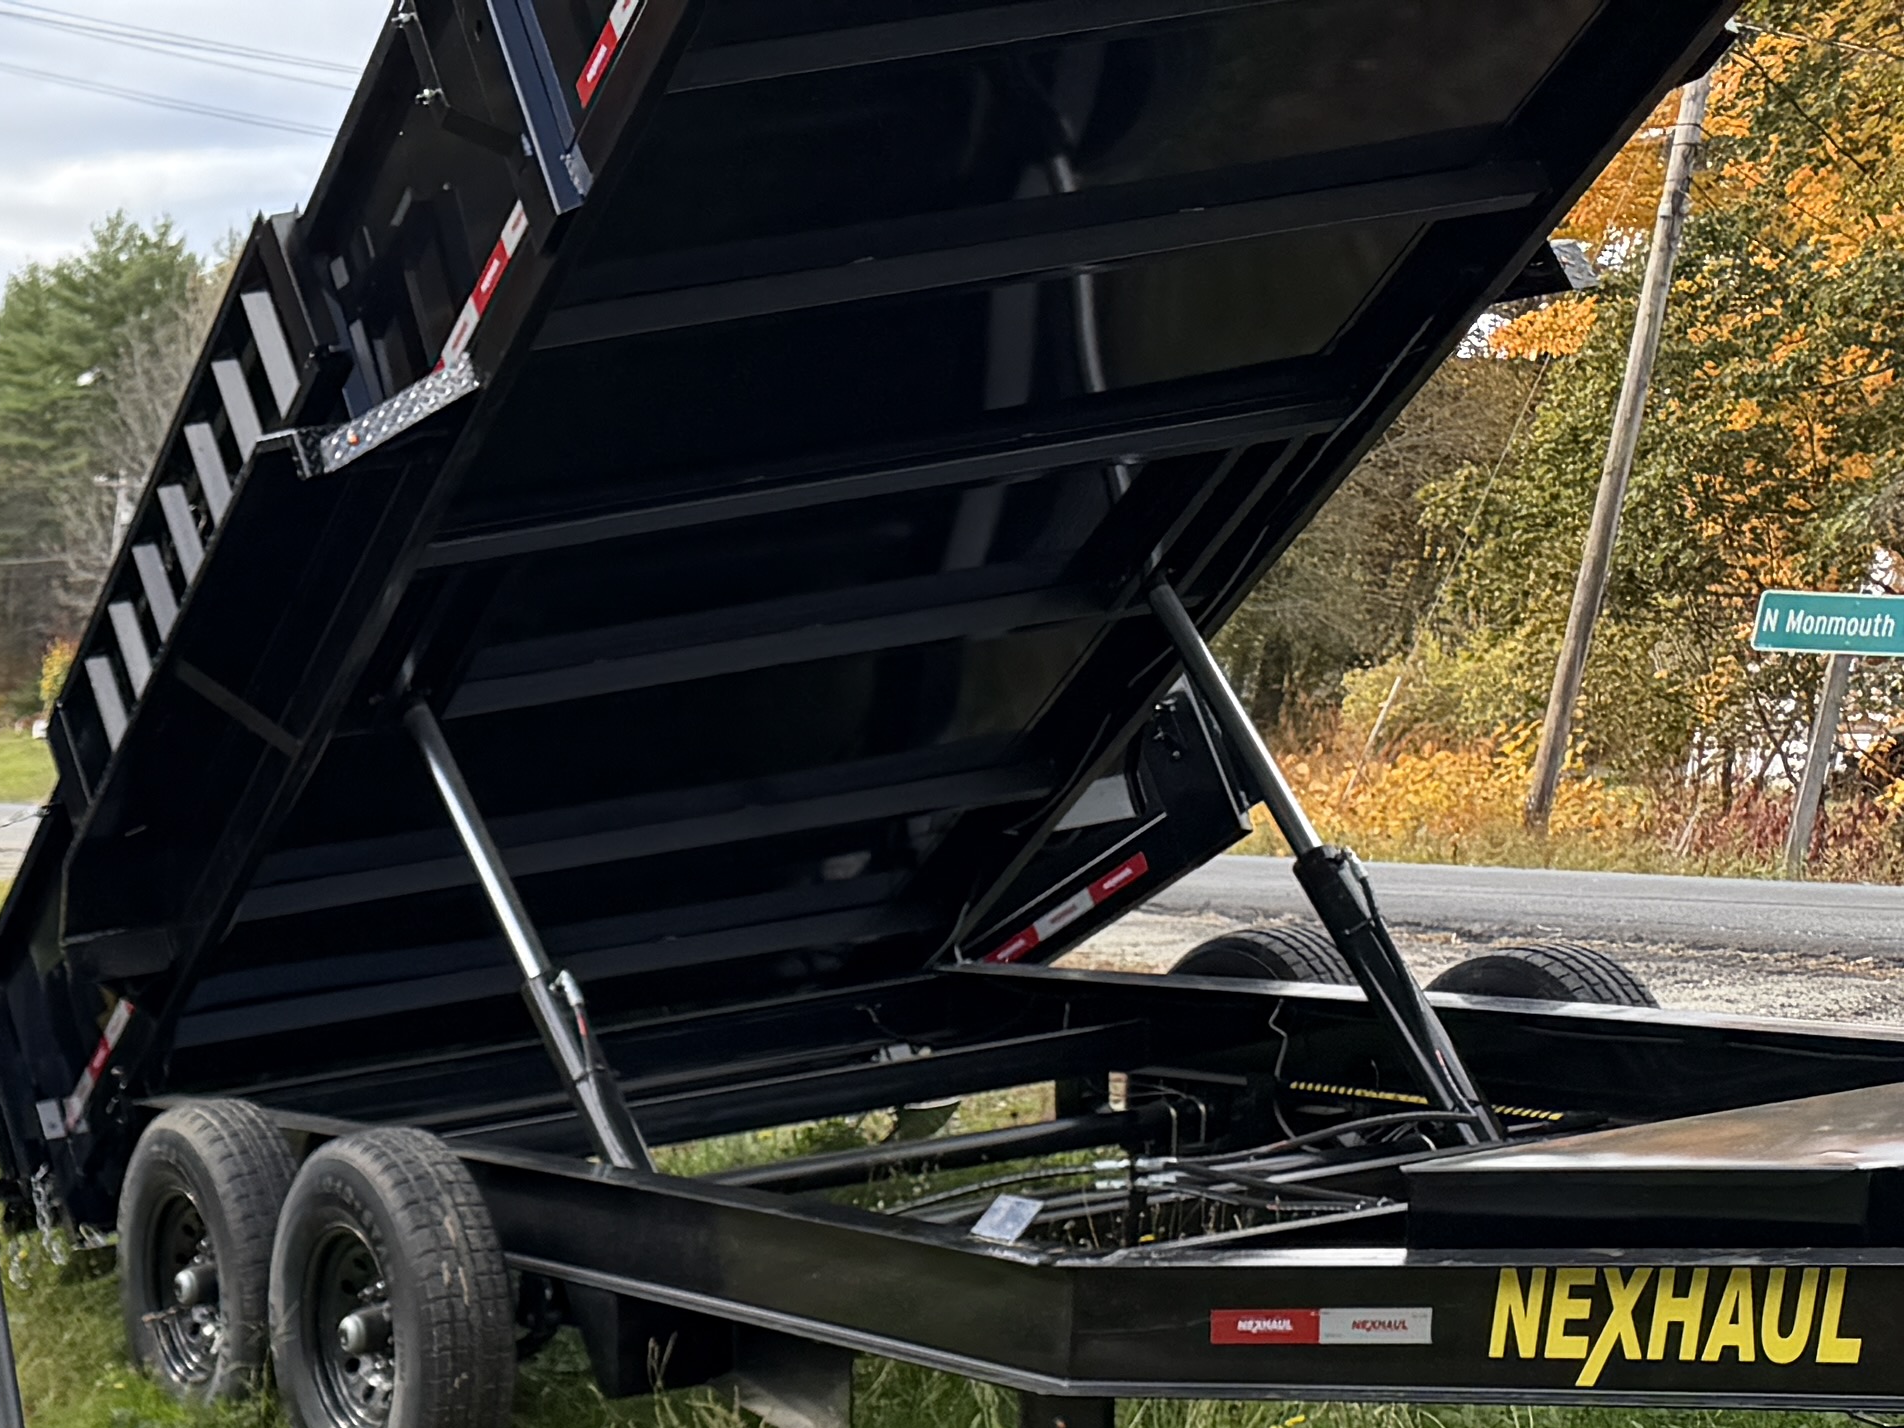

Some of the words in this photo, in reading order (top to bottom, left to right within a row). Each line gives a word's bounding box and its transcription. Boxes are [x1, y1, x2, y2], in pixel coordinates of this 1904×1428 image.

[1762, 608, 1779, 632] N
[1785, 609, 1895, 637] Monmouth
[1488, 1267, 1862, 1387] NEXHAUL
